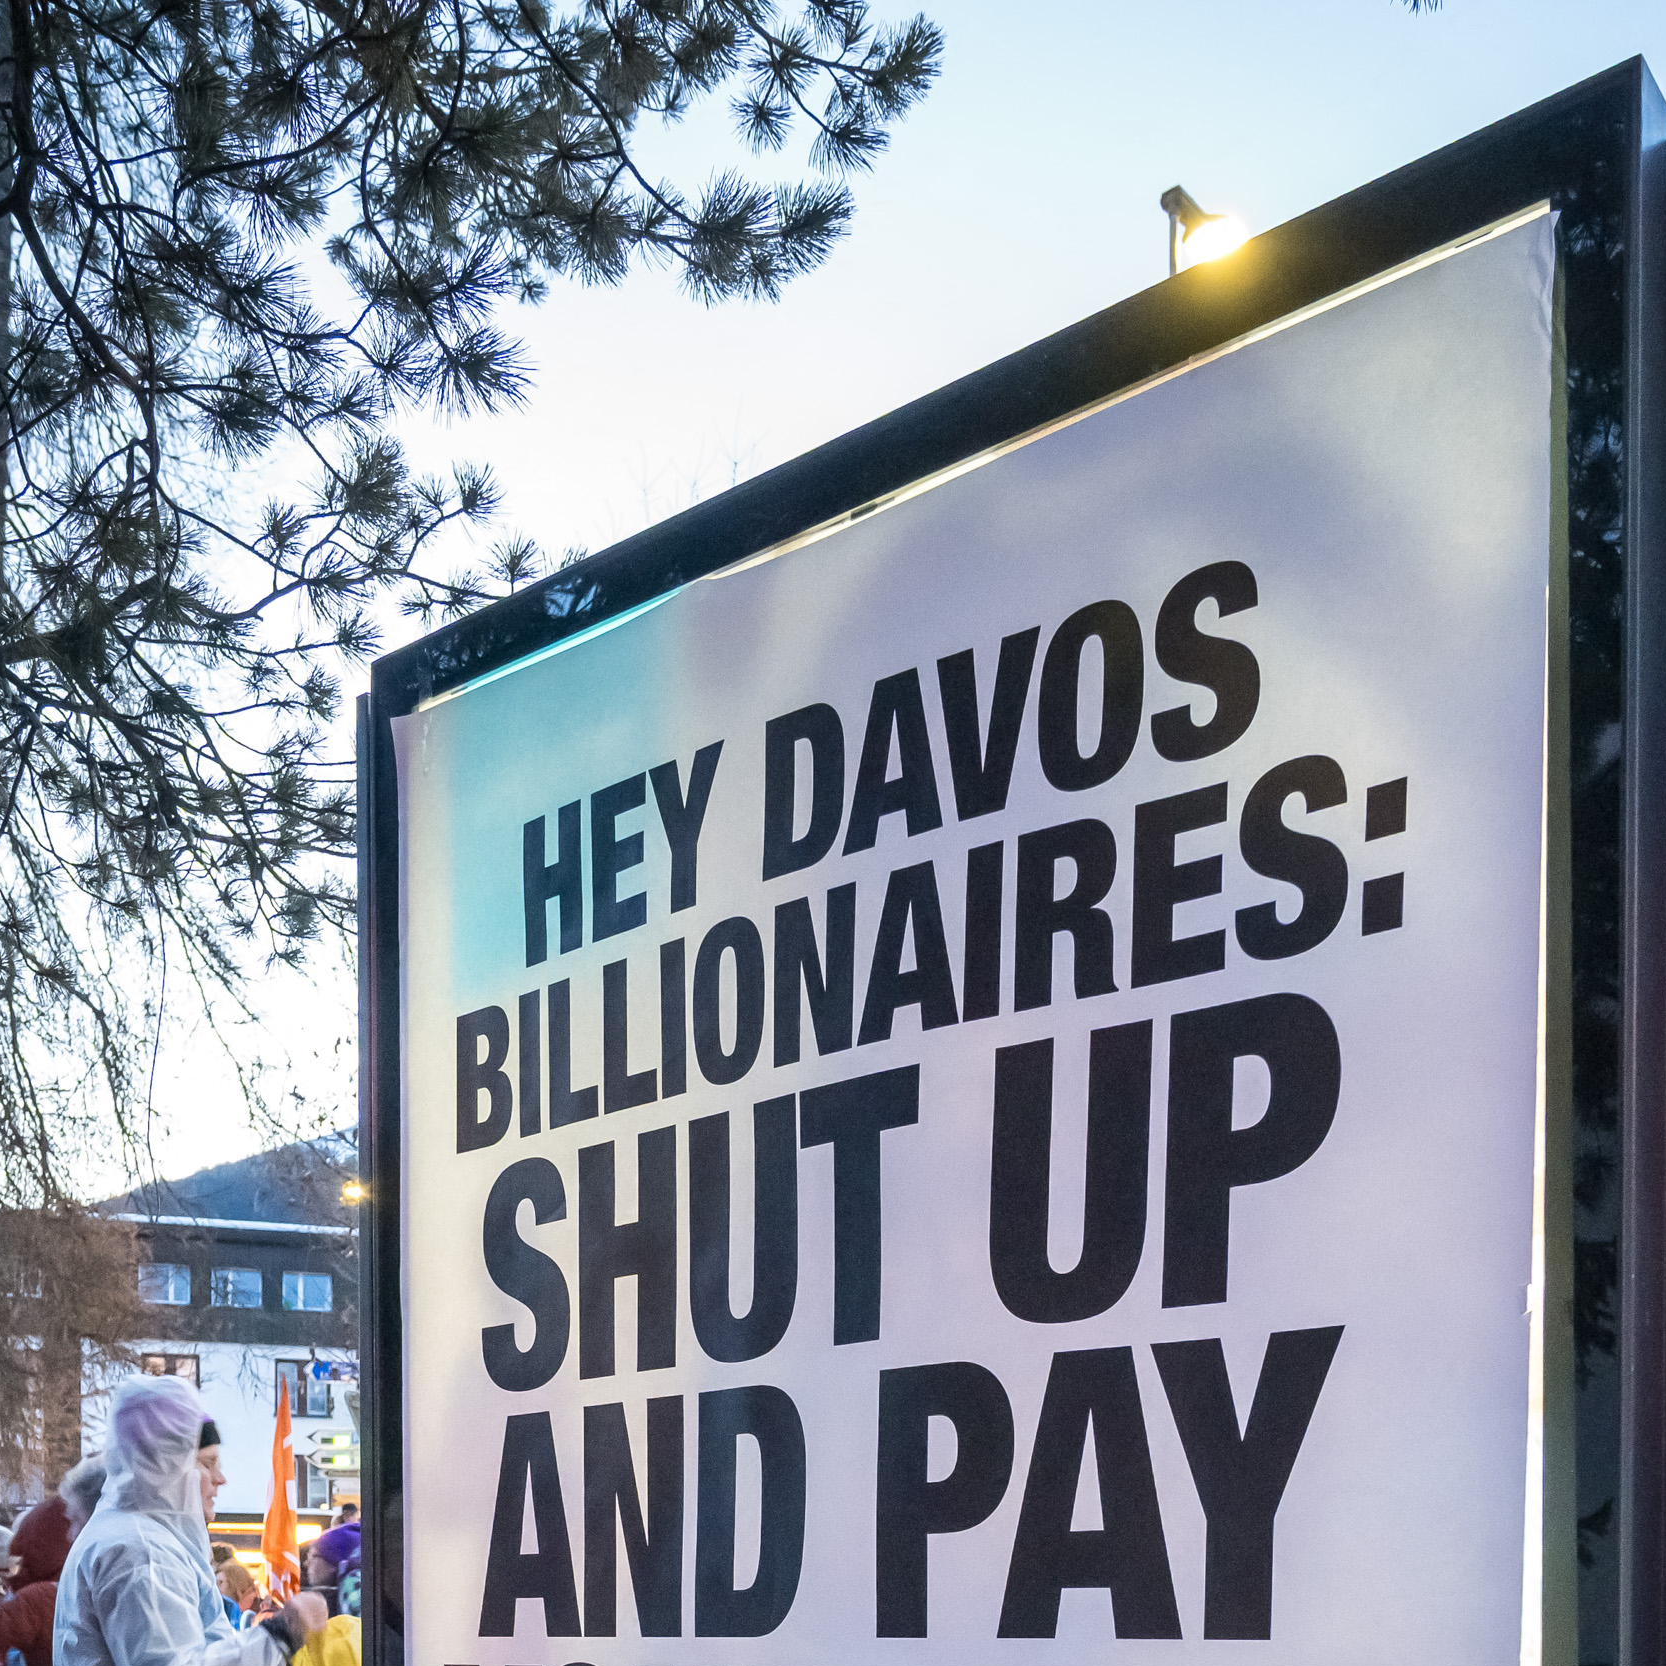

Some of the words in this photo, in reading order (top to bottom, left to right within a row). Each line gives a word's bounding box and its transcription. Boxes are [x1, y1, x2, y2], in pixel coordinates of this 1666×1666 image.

[456, 754, 1408, 1154] BILLIONAIRES:
[523, 739, 725, 968] HEY
[762, 560, 1261, 882] DAVOS
[481, 1063, 921, 1392] SHUT
[989, 992, 1342, 1324] UP
[478, 1384, 807, 1638] AND
[876, 1324, 1346, 1641] PAY
